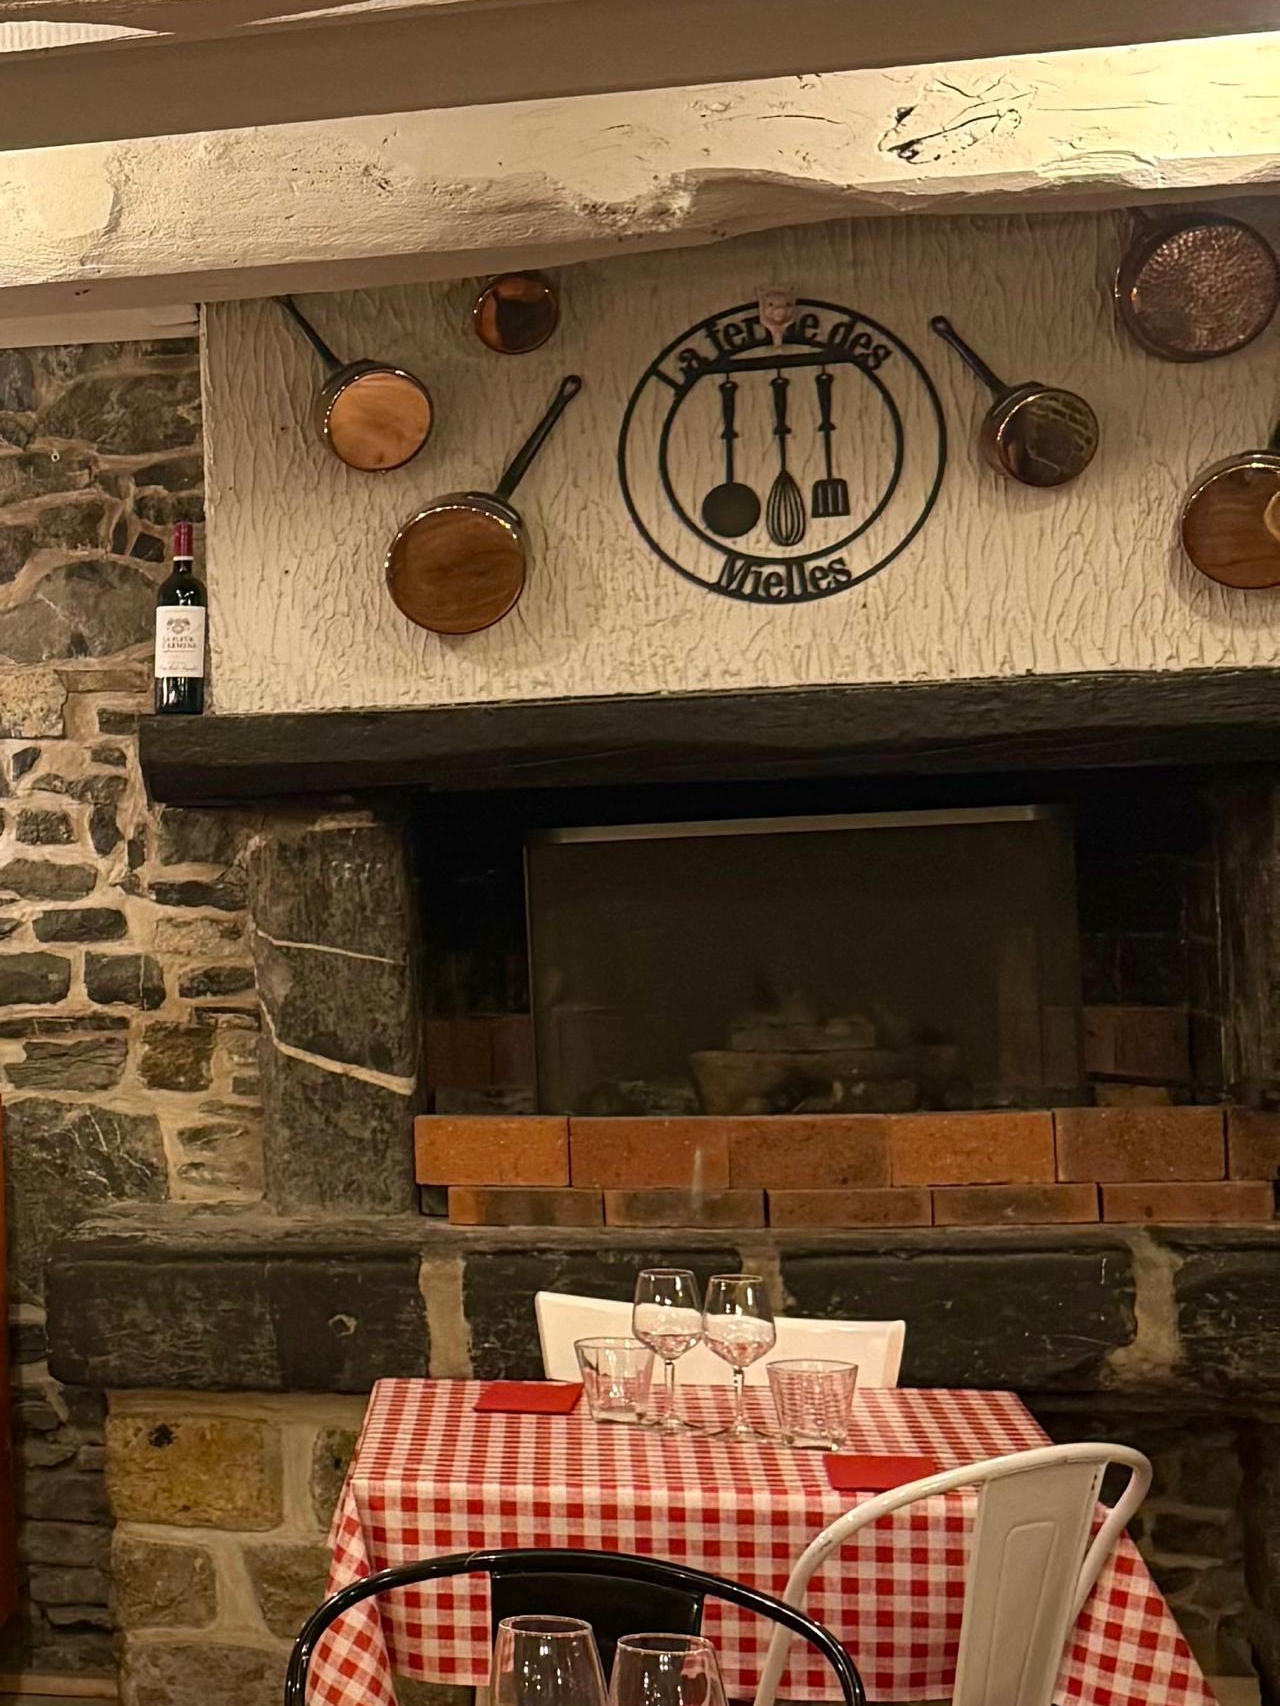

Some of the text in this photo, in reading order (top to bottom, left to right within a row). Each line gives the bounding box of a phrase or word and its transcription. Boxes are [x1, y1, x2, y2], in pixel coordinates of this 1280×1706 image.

[653, 346, 710, 394] La
[827, 318, 892, 372] des
[714, 553, 852, 597] Mielles
